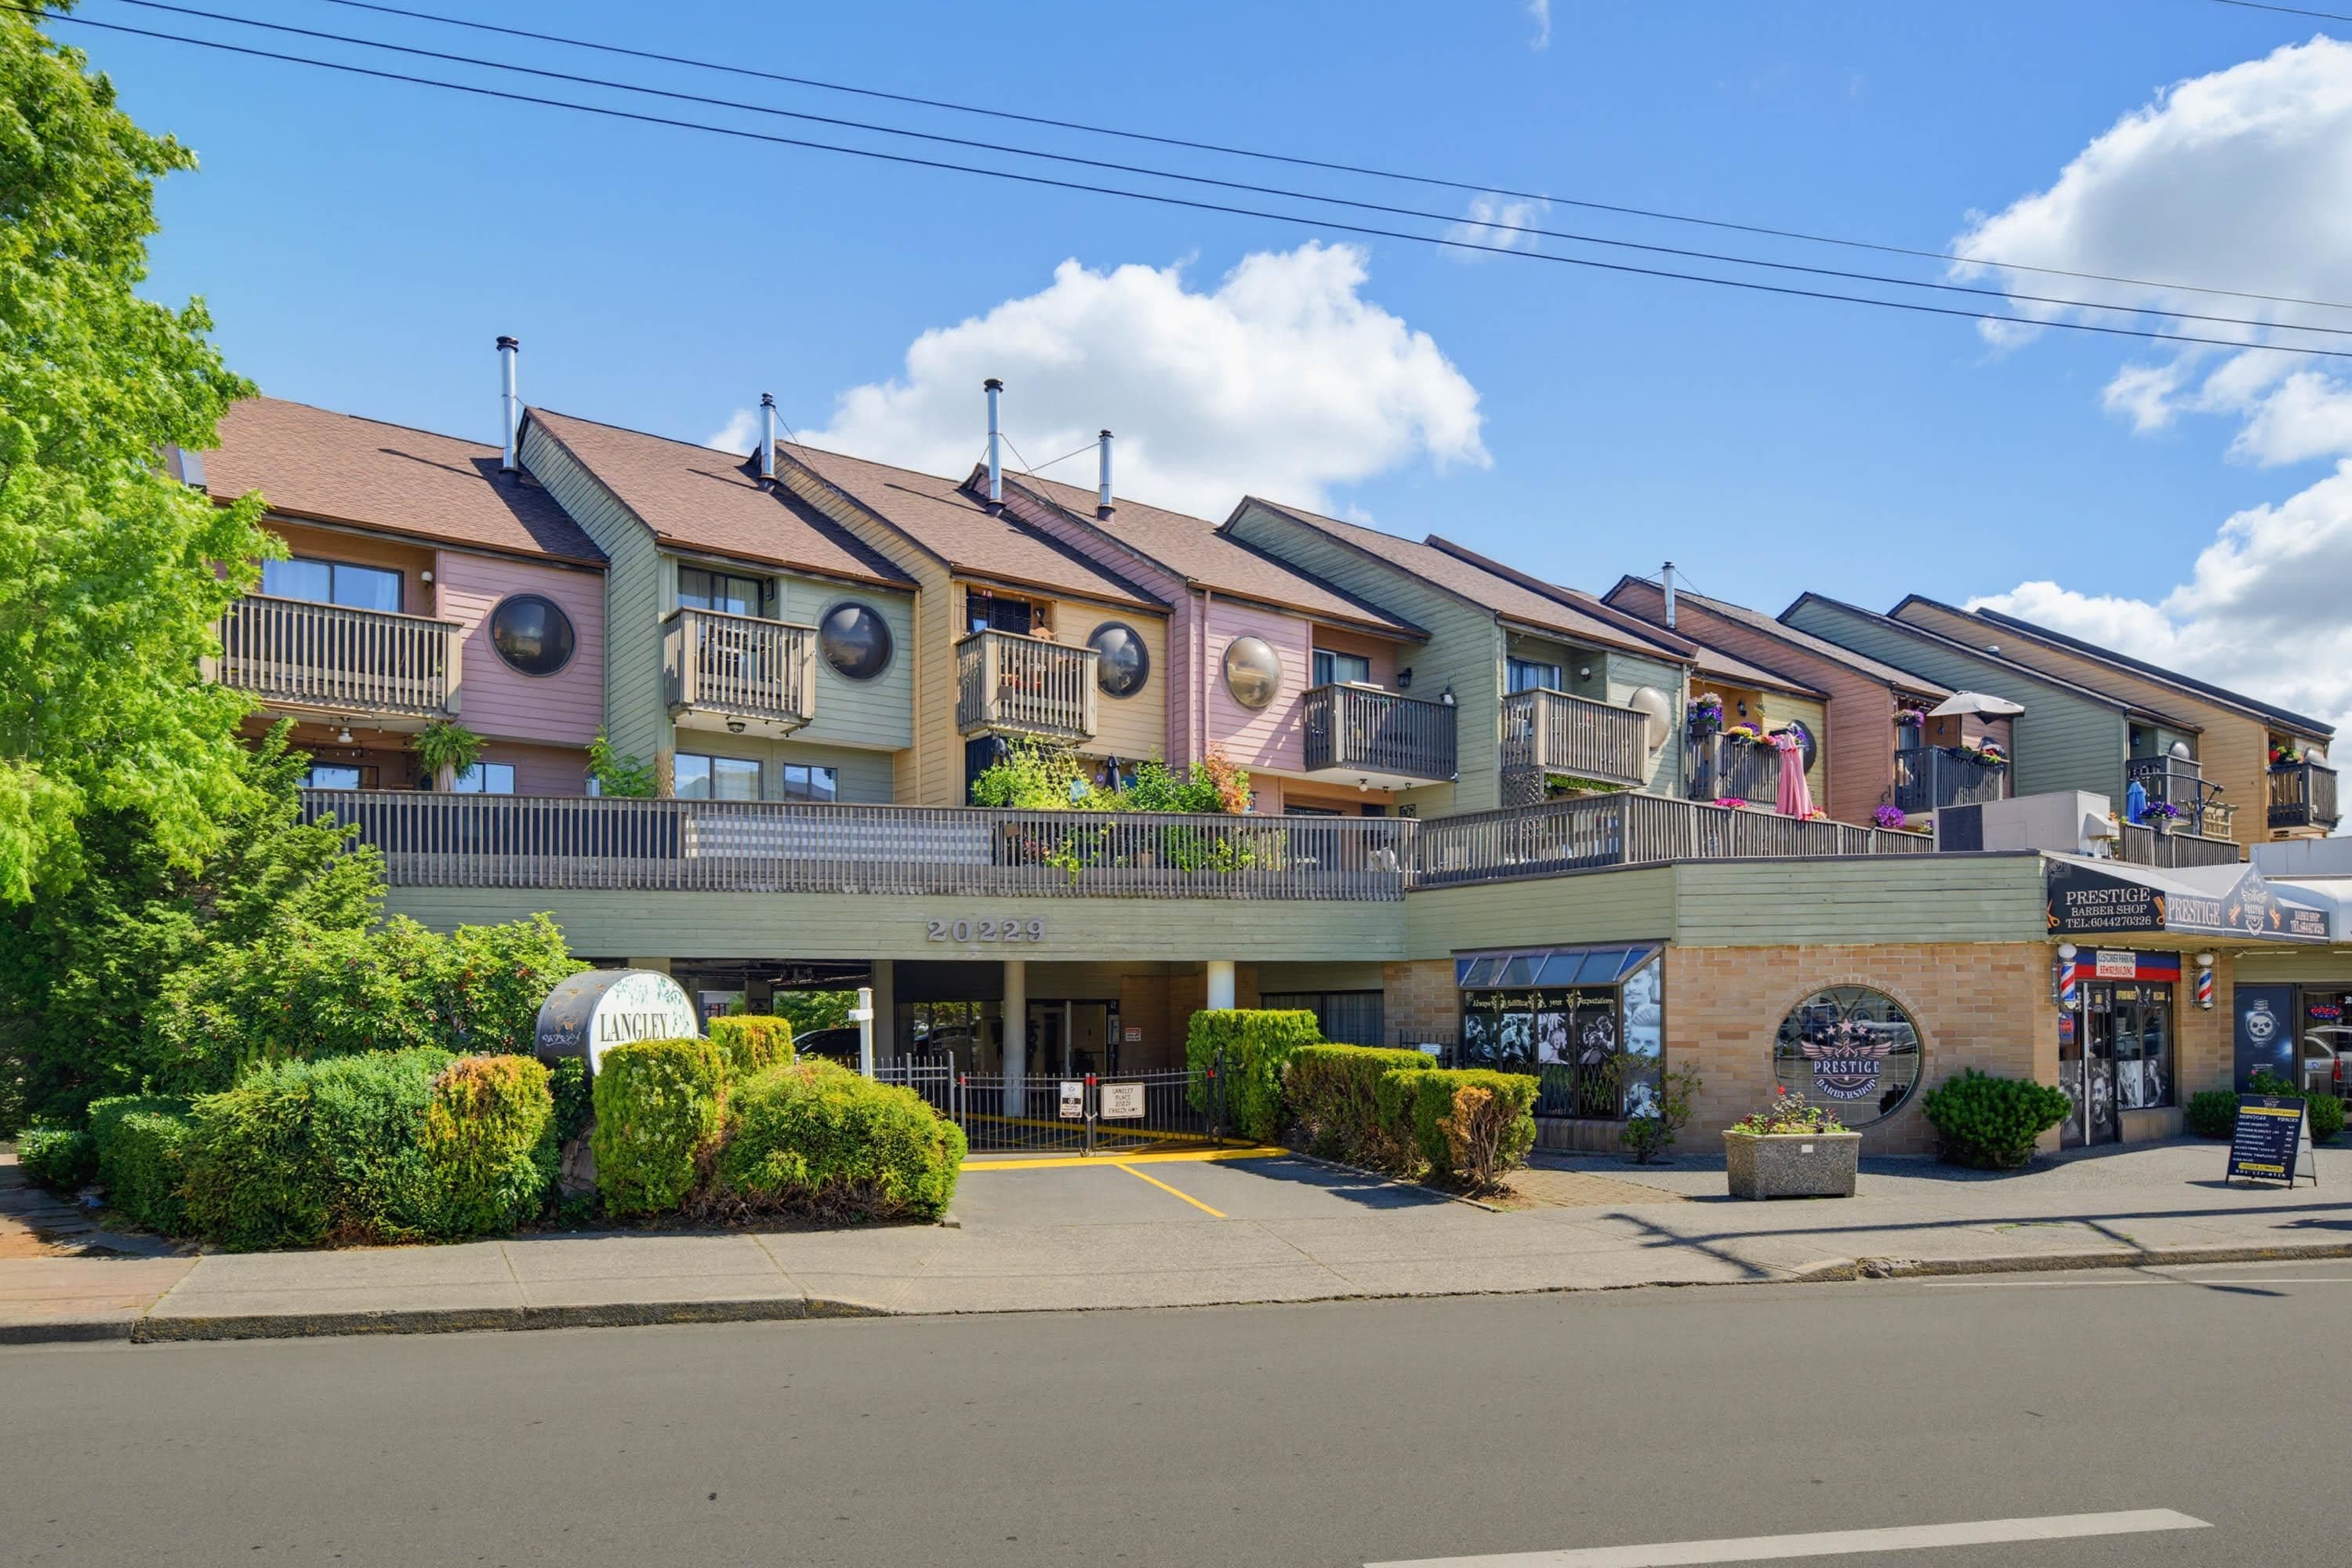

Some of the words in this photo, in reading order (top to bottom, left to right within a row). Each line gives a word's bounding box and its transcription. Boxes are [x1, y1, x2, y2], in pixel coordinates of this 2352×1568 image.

[2065, 887, 2151, 905] PRESTIGE
[2071, 906, 2114, 916] BARBER
[2116, 904, 2147, 915] SHOP
[2168, 897, 2221, 925] PRESTIGE
[927, 916, 1047, 942] 20229
[600, 1012, 669, 1043] LANGLEY
[1813, 1060, 1880, 1074] PRESTIGE
[1816, 1078, 1876, 1099] BARBERSHOP
